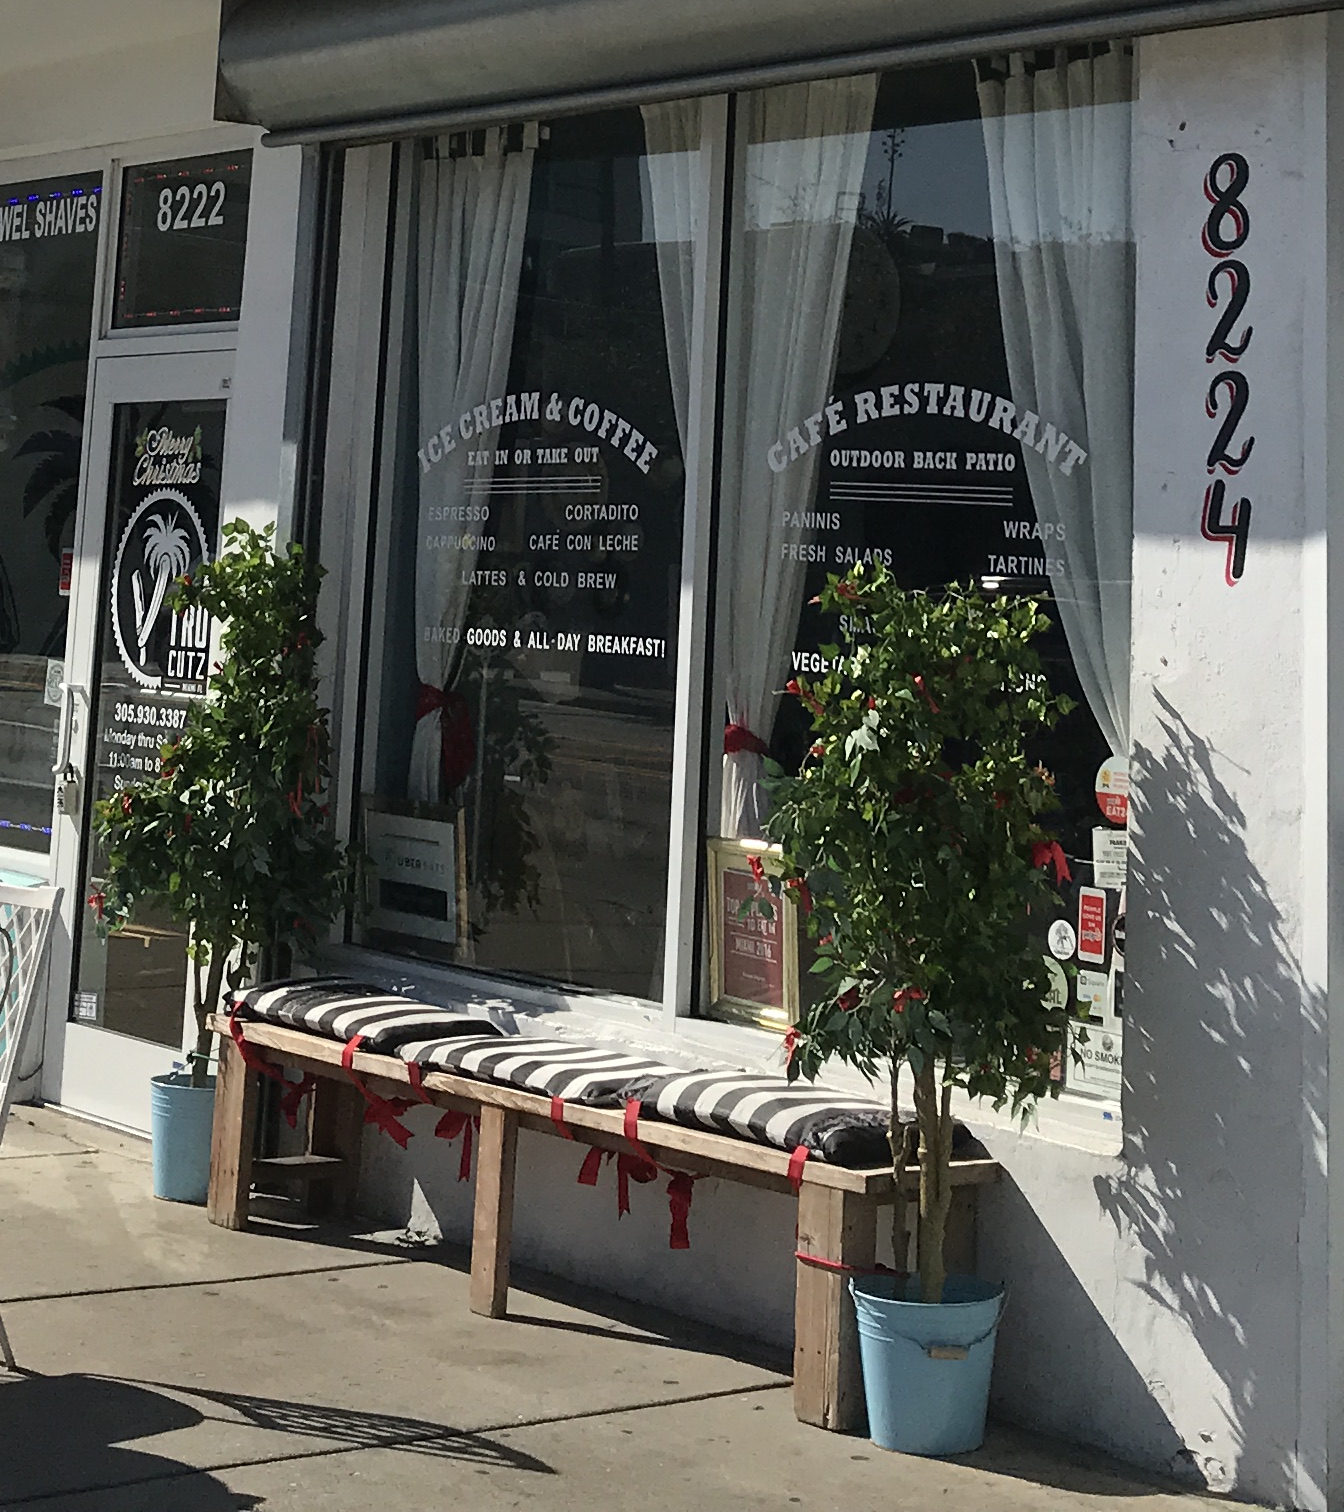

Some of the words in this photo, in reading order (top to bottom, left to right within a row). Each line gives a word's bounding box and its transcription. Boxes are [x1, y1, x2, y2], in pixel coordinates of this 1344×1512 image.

[35, 194, 98, 239] SHAVES
[156, 181, 226, 232] 8222
[1202, 152, 1255, 587] 8224
[145, 426, 194, 462] Merry
[417, 425, 456, 474] ICE
[458, 392, 540, 440] CREAM
[545, 392, 562, 422] &
[568, 396, 658, 474] COFFEE
[766, 394, 848, 474] CAFÉ
[854, 382, 1088, 477] RESTAURANT
[467, 449, 489, 466] EAT
[494, 449, 508, 465] IN
[514, 448, 531, 465] OR
[536, 448, 568, 464] TAKE
[575, 447, 600, 464] OUT
[829, 449, 905, 469] OUTDOOR
[913, 451, 957, 470] BACK
[965, 452, 1016, 472] PATIO
[133, 459, 201, 487] Christmas
[428, 505, 490, 522] ESPRESSO
[565, 505, 639, 521] CORTADITO
[781, 511, 841, 530] PANINIS
[1003, 520, 1066, 541] WRAPS
[426, 535, 496, 553] CAPPUCCINO
[566, 534, 592, 551] CON
[599, 534, 639, 551] LECHE
[781, 544, 826, 563] FRESH
[835, 546, 893, 566] SALADS
[987, 554, 1065, 576] TARTINES
[461, 570, 506, 586] LATTES
[518, 571, 526, 586] &
[534, 571, 570, 587] COLD
[578, 573, 617, 589] BREW
[424, 626, 460, 644] BAKED
[466, 628, 507, 647] GOODS
[513, 631, 521, 648] &
[587, 634, 666, 659] BREAKFAST!
[167, 649, 206, 680] CUTZ
[114, 702, 187, 730] 305.930.3387
[138, 732, 155, 749] thru
[145, 756, 153, 772] to
[1081, 1048, 1093, 1060] NO
